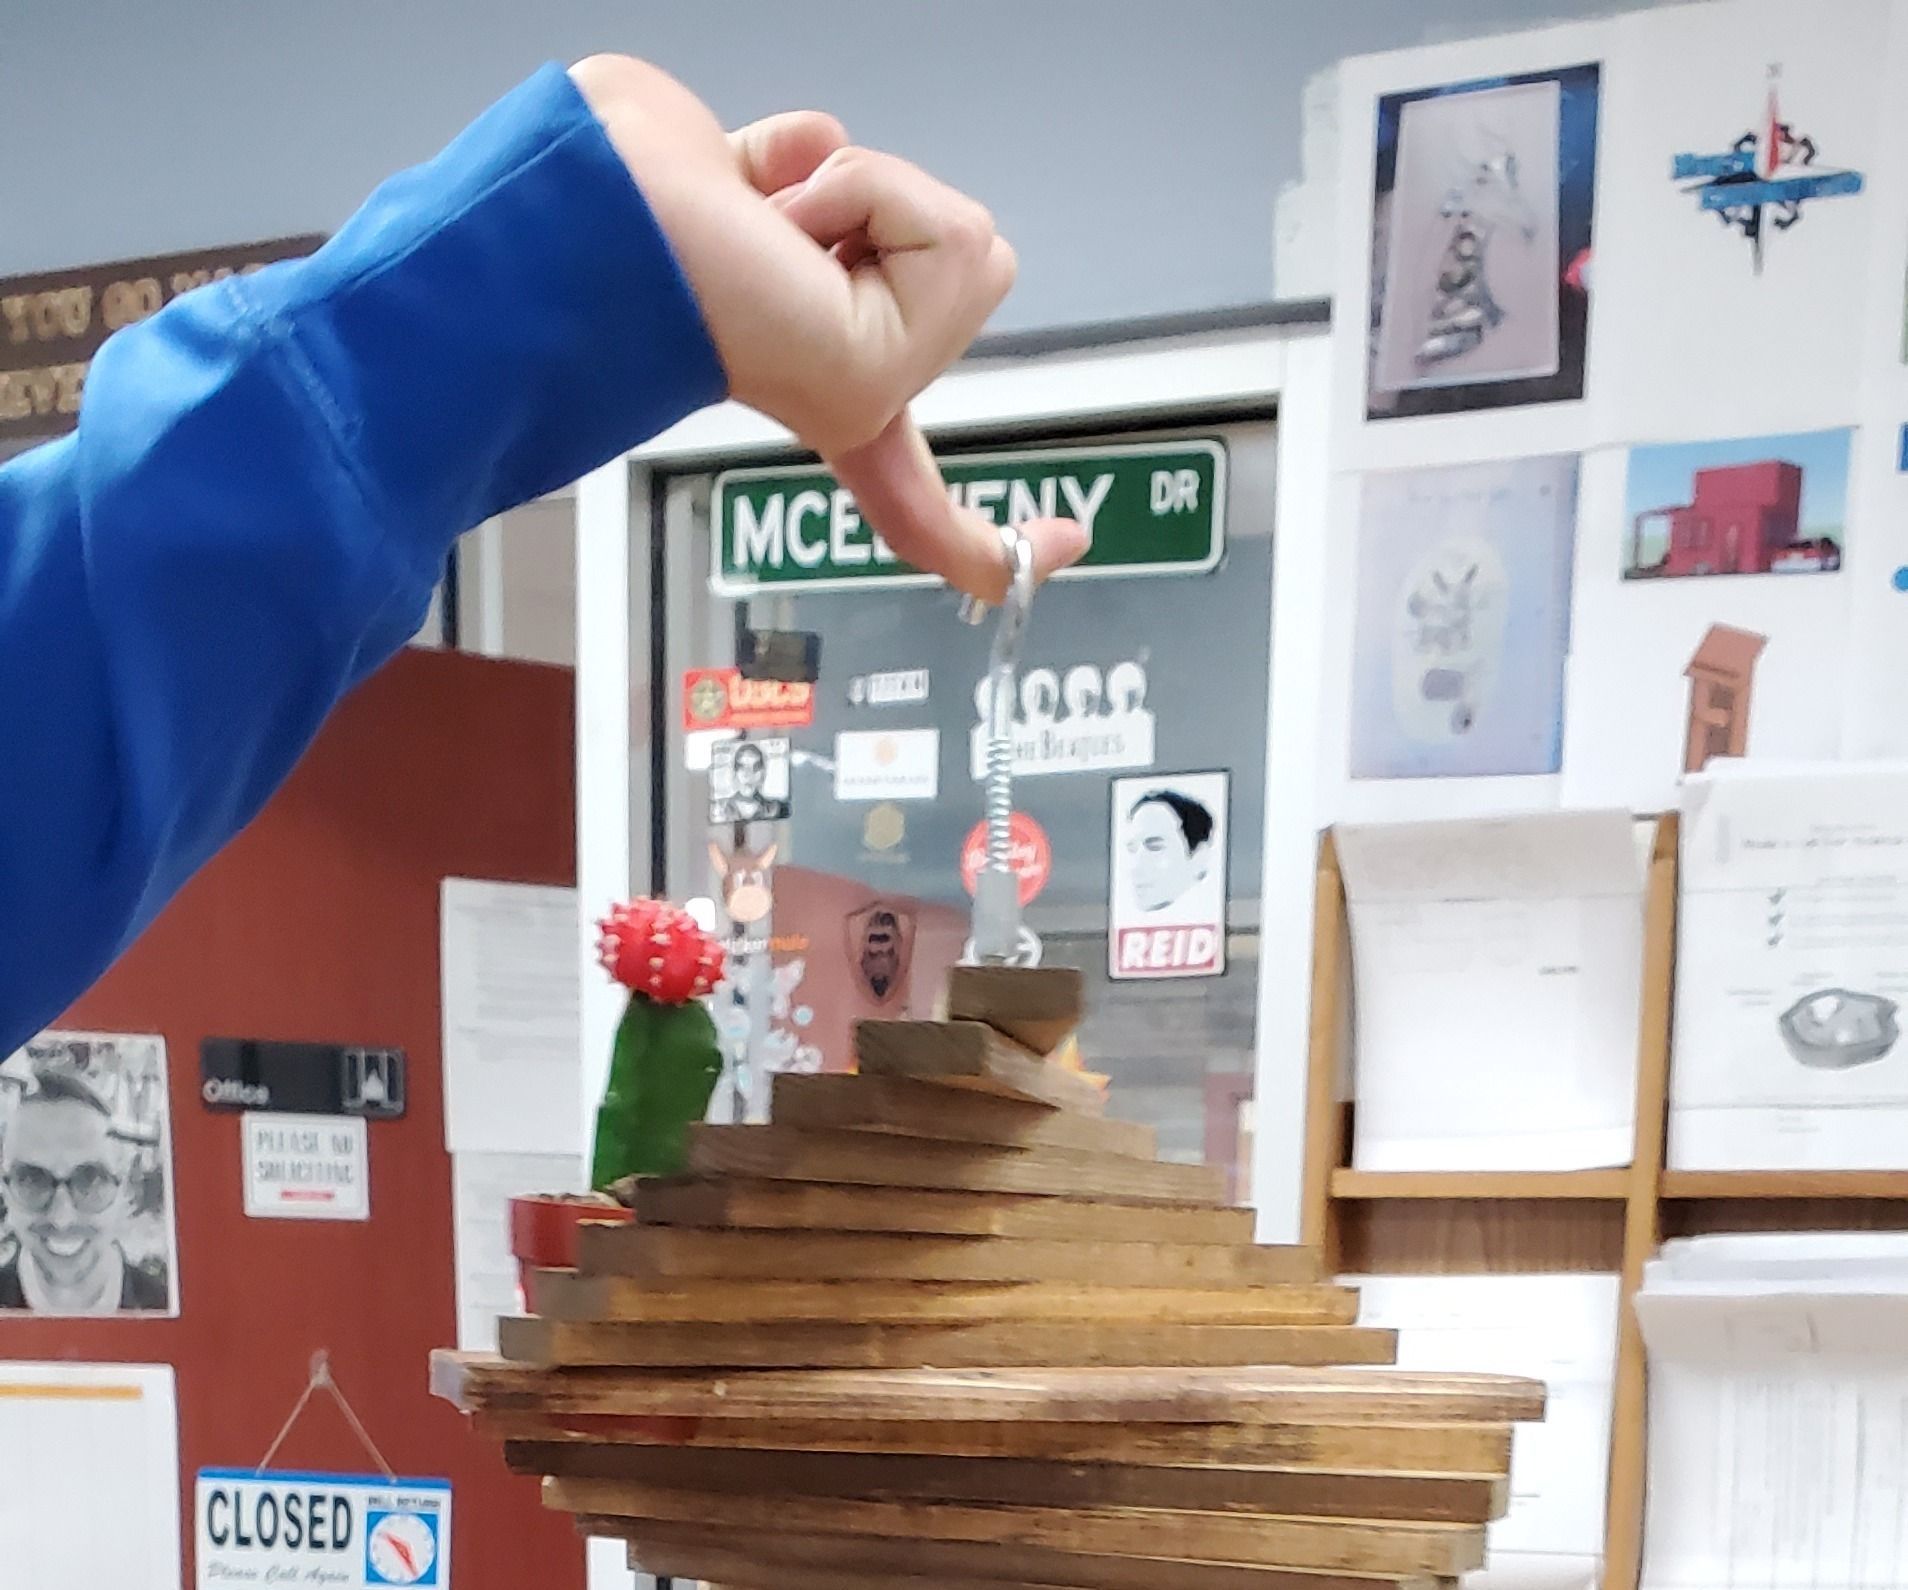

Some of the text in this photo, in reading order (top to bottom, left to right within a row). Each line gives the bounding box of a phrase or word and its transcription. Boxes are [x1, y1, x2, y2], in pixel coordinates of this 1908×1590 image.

[732, 468, 1200, 570] MCEENY DR
[1121, 928, 1217, 970] REID
[207, 1489, 353, 1550] CLOSED
